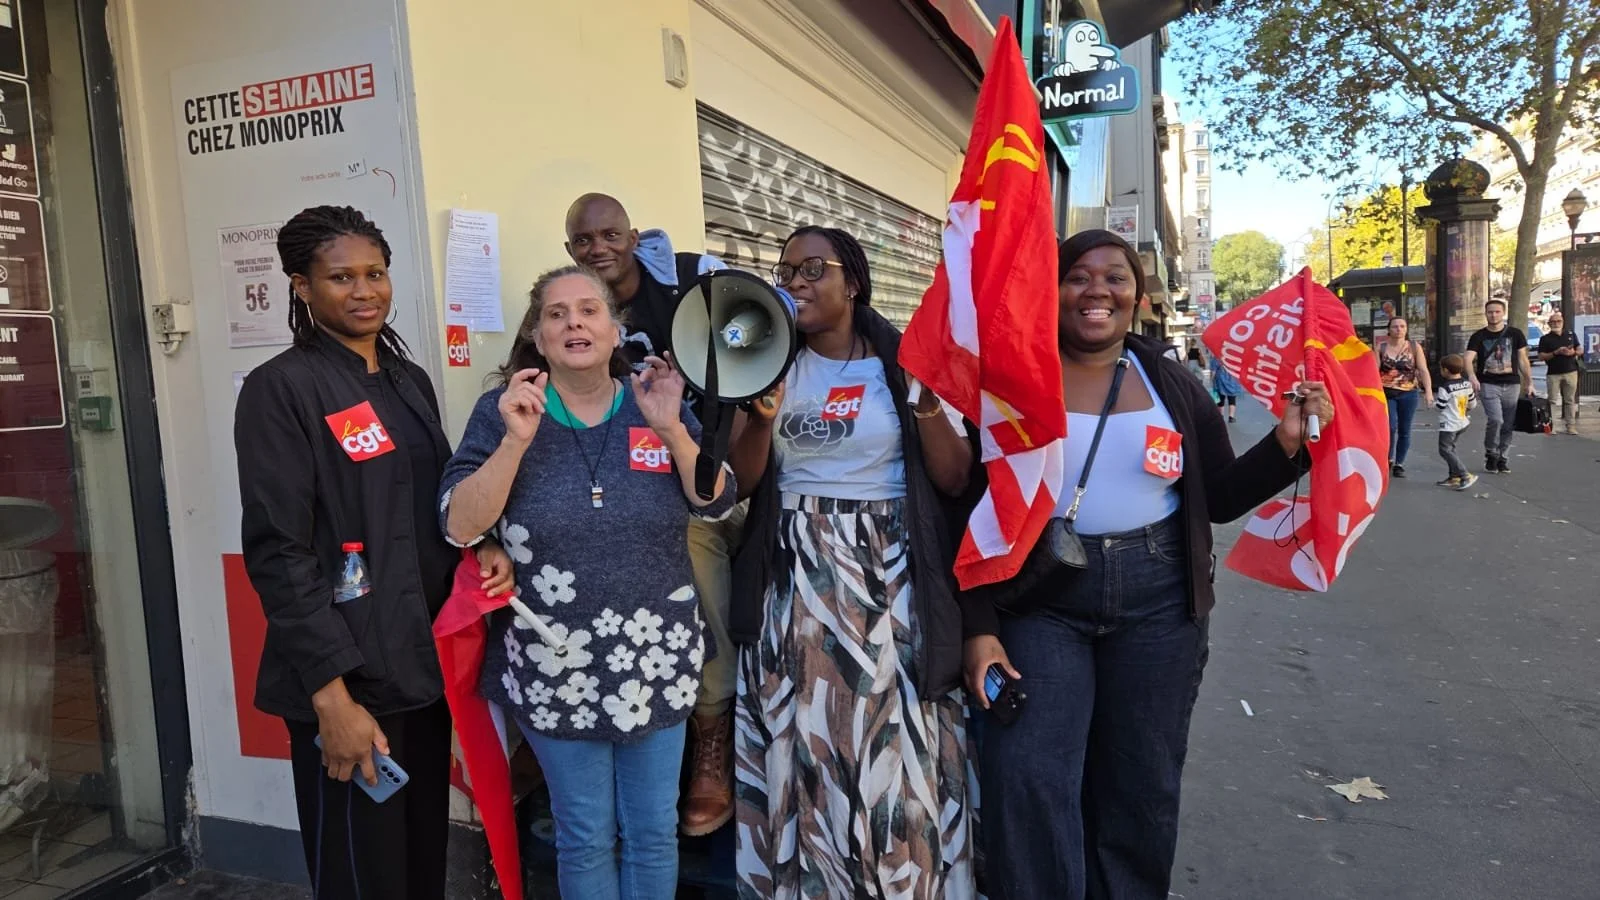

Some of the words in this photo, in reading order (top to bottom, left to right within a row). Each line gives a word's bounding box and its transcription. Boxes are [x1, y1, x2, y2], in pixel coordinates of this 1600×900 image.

[184, 91, 242, 125] CETTE
[245, 65, 373, 115] SEMAINE
[1044, 77, 1125, 110] Normal
[187, 124, 236, 155] CHEZ
[240, 105, 345, 148] MONOPRIX
[221, 228, 280, 245] MONOPRIX
[245, 283, 270, 312] 5€
[449, 341, 470, 363] cgt
[825, 397, 861, 417] cgt
[342, 422, 388, 454] cgt
[631, 445, 670, 468] cgt
[1146, 448, 1180, 473] cgt
